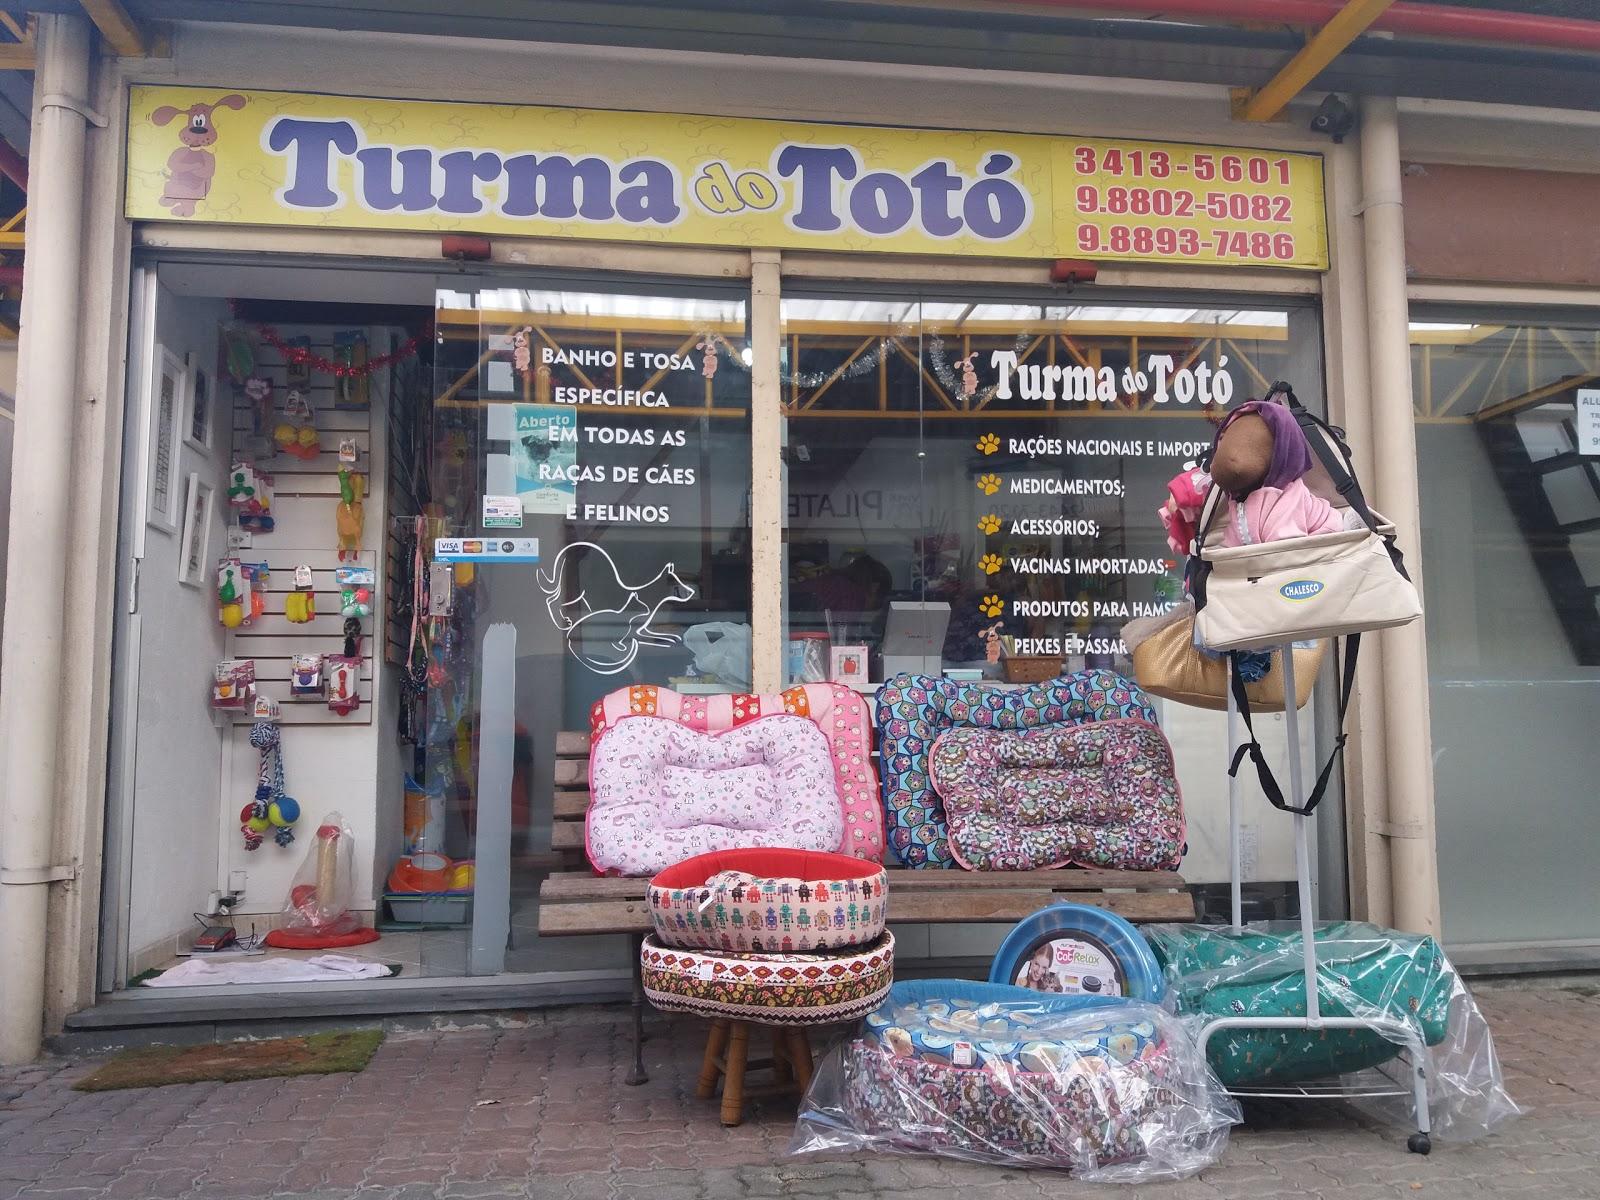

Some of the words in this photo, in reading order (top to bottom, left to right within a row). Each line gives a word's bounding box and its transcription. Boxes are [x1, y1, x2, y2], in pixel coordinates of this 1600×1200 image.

[1075, 147, 1290, 186] 3413-5601
[267, 118, 681, 224] Turma
[694, 161, 778, 214] do
[776, 143, 1027, 239] Totó
[1076, 184, 1292, 223] 9.8802-5082
[1076, 224, 1294, 261] 9.8893-7486
[542, 347, 617, 368] BANHO
[624, 352, 635, 368] E
[641, 353, 695, 371] TOSA
[990, 350, 1118, 402] Turma
[1121, 366, 1149, 395] do
[1147, 354, 1233, 405] Totó
[555, 386, 669, 408] ESPECÍFICA
[518, 414, 571, 429] Aberto
[548, 426, 578, 443] EM
[585, 427, 655, 446] TODAS
[660, 430, 686, 447] AS
[1009, 435, 1062, 459] RAÇÕES
[1066, 439, 1142, 456] NACIONAIS
[1147, 441, 1154, 456] E
[539, 464, 605, 486] RAÇAS
[612, 466, 639, 483] DE
[645, 464, 695, 485] CÃES
[1010, 478, 1125, 498] MEDICAMENTOS;
[565, 503, 577, 520] E
[584, 504, 669, 522] FELINOS
[1010, 515, 1100, 538] ACESSÓRIOS;
[441, 542, 458, 550] VISA
[1010, 557, 1071, 574] VACINAS
[1075, 558, 1169, 577] IMPORTADAS;
[1285, 583, 1319, 597] CHALESCO
[1013, 600, 1089, 617] PRODUTOS
[1093, 601, 1130, 617] PARA
[1014, 638, 1061, 655] PEIXES
[1065, 638, 1073, 655] E
[1073, 952, 1100, 965] Relax
